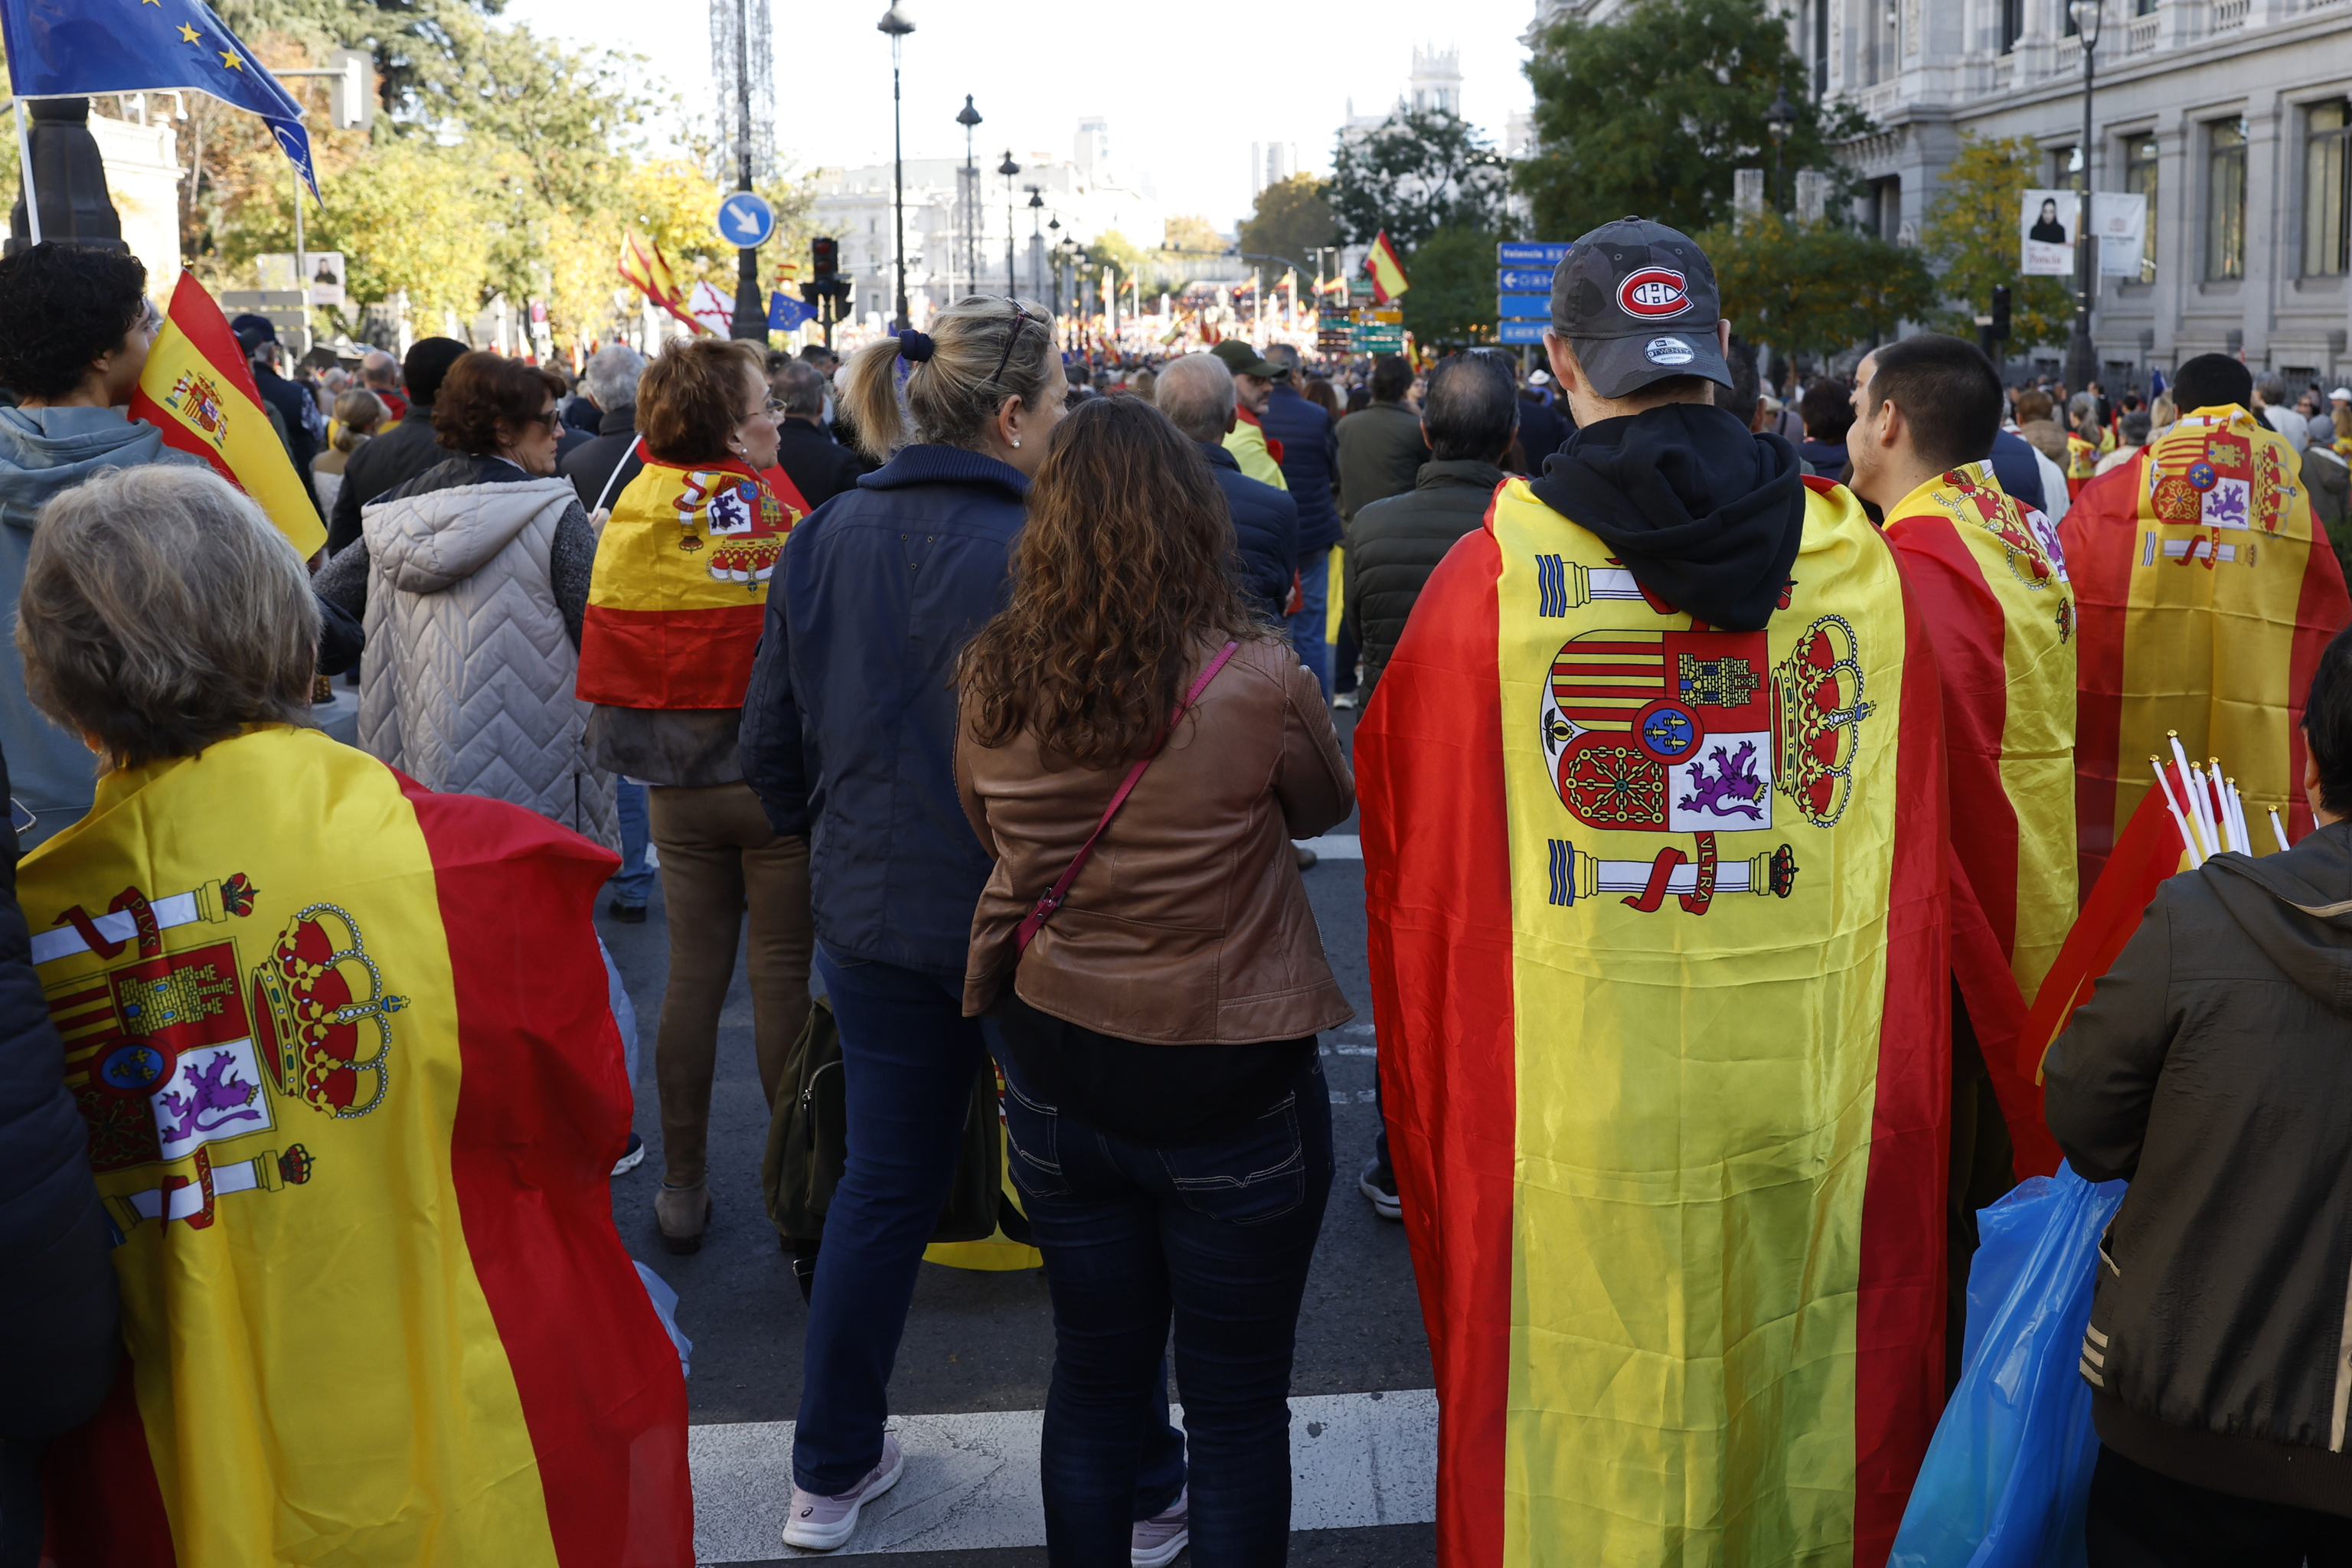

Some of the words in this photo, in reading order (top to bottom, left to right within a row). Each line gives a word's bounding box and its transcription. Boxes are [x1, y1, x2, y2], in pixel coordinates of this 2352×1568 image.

[1648, 348, 1690, 358] 9TWENTY
[1697, 837, 1713, 902] VLTRA
[129, 897, 156, 947] PLVS
